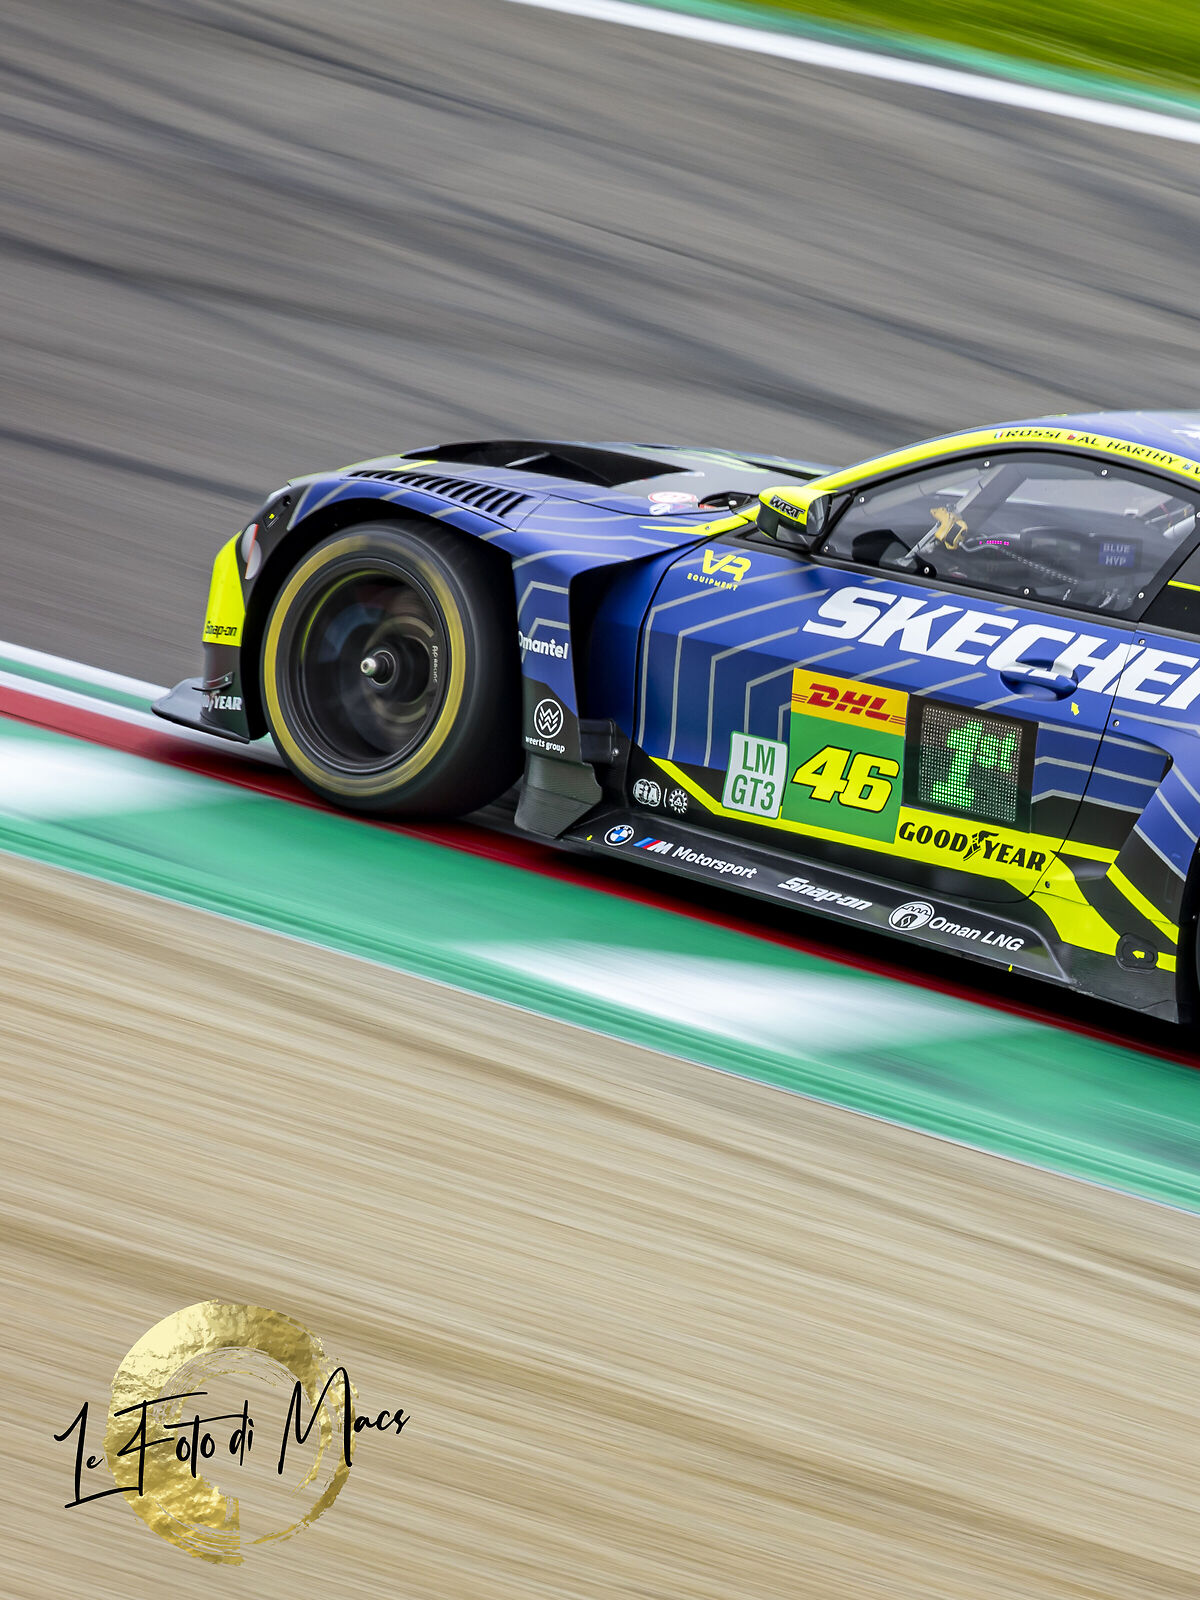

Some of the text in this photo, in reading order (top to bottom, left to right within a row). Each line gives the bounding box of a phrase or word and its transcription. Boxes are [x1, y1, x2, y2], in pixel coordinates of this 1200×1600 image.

[687, 572, 739, 592] EQUIPMENT
[702, 549, 752, 583] VR
[806, 682, 892, 722] DHL
[545, 741, 566, 754] group
[742, 740, 777, 777] LM
[731, 774, 776, 811] GT3
[791, 744, 901, 814] 46
[671, 846, 758, 880] Motorsport
[777, 876, 873, 911] Snap-on
[928, 916, 1026, 952] Oman LNG
